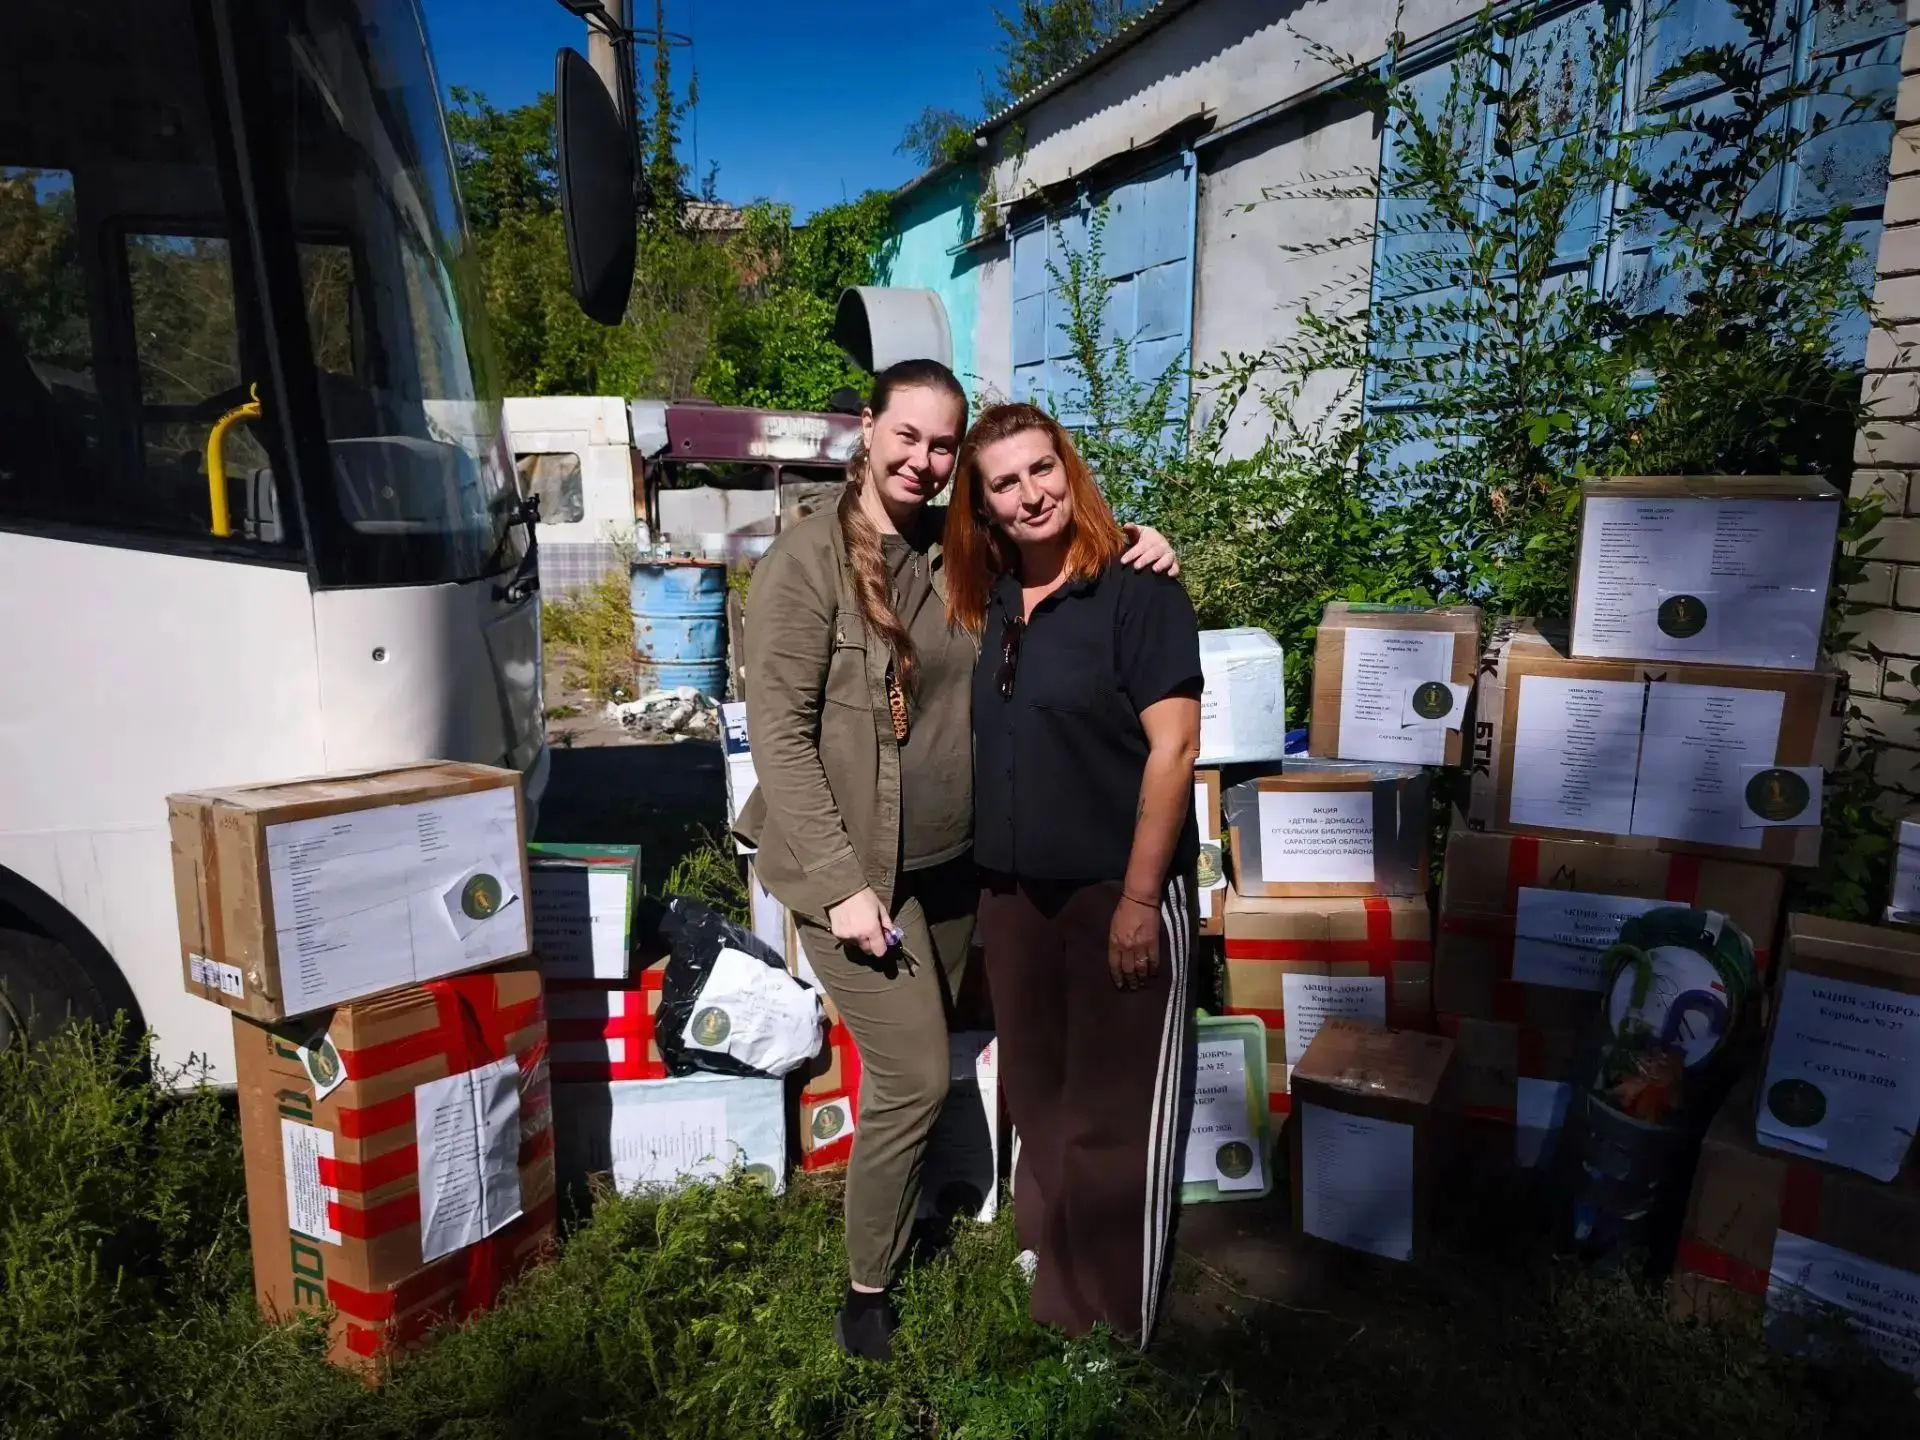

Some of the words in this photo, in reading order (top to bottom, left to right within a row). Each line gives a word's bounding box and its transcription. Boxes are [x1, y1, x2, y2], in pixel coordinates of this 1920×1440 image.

[1312, 807, 1339, 815] АКЦИЯ
[1284, 837, 1338, 845] САРАТОВСКОЙ
[1303, 984, 1333, 993] АКЦИЯ
[1812, 989, 1857, 1006] АКЦИЯ
[1198, 1051, 1233, 1060] ДОБРО»
[1833, 1268, 1881, 1294] АКЦИЯ
